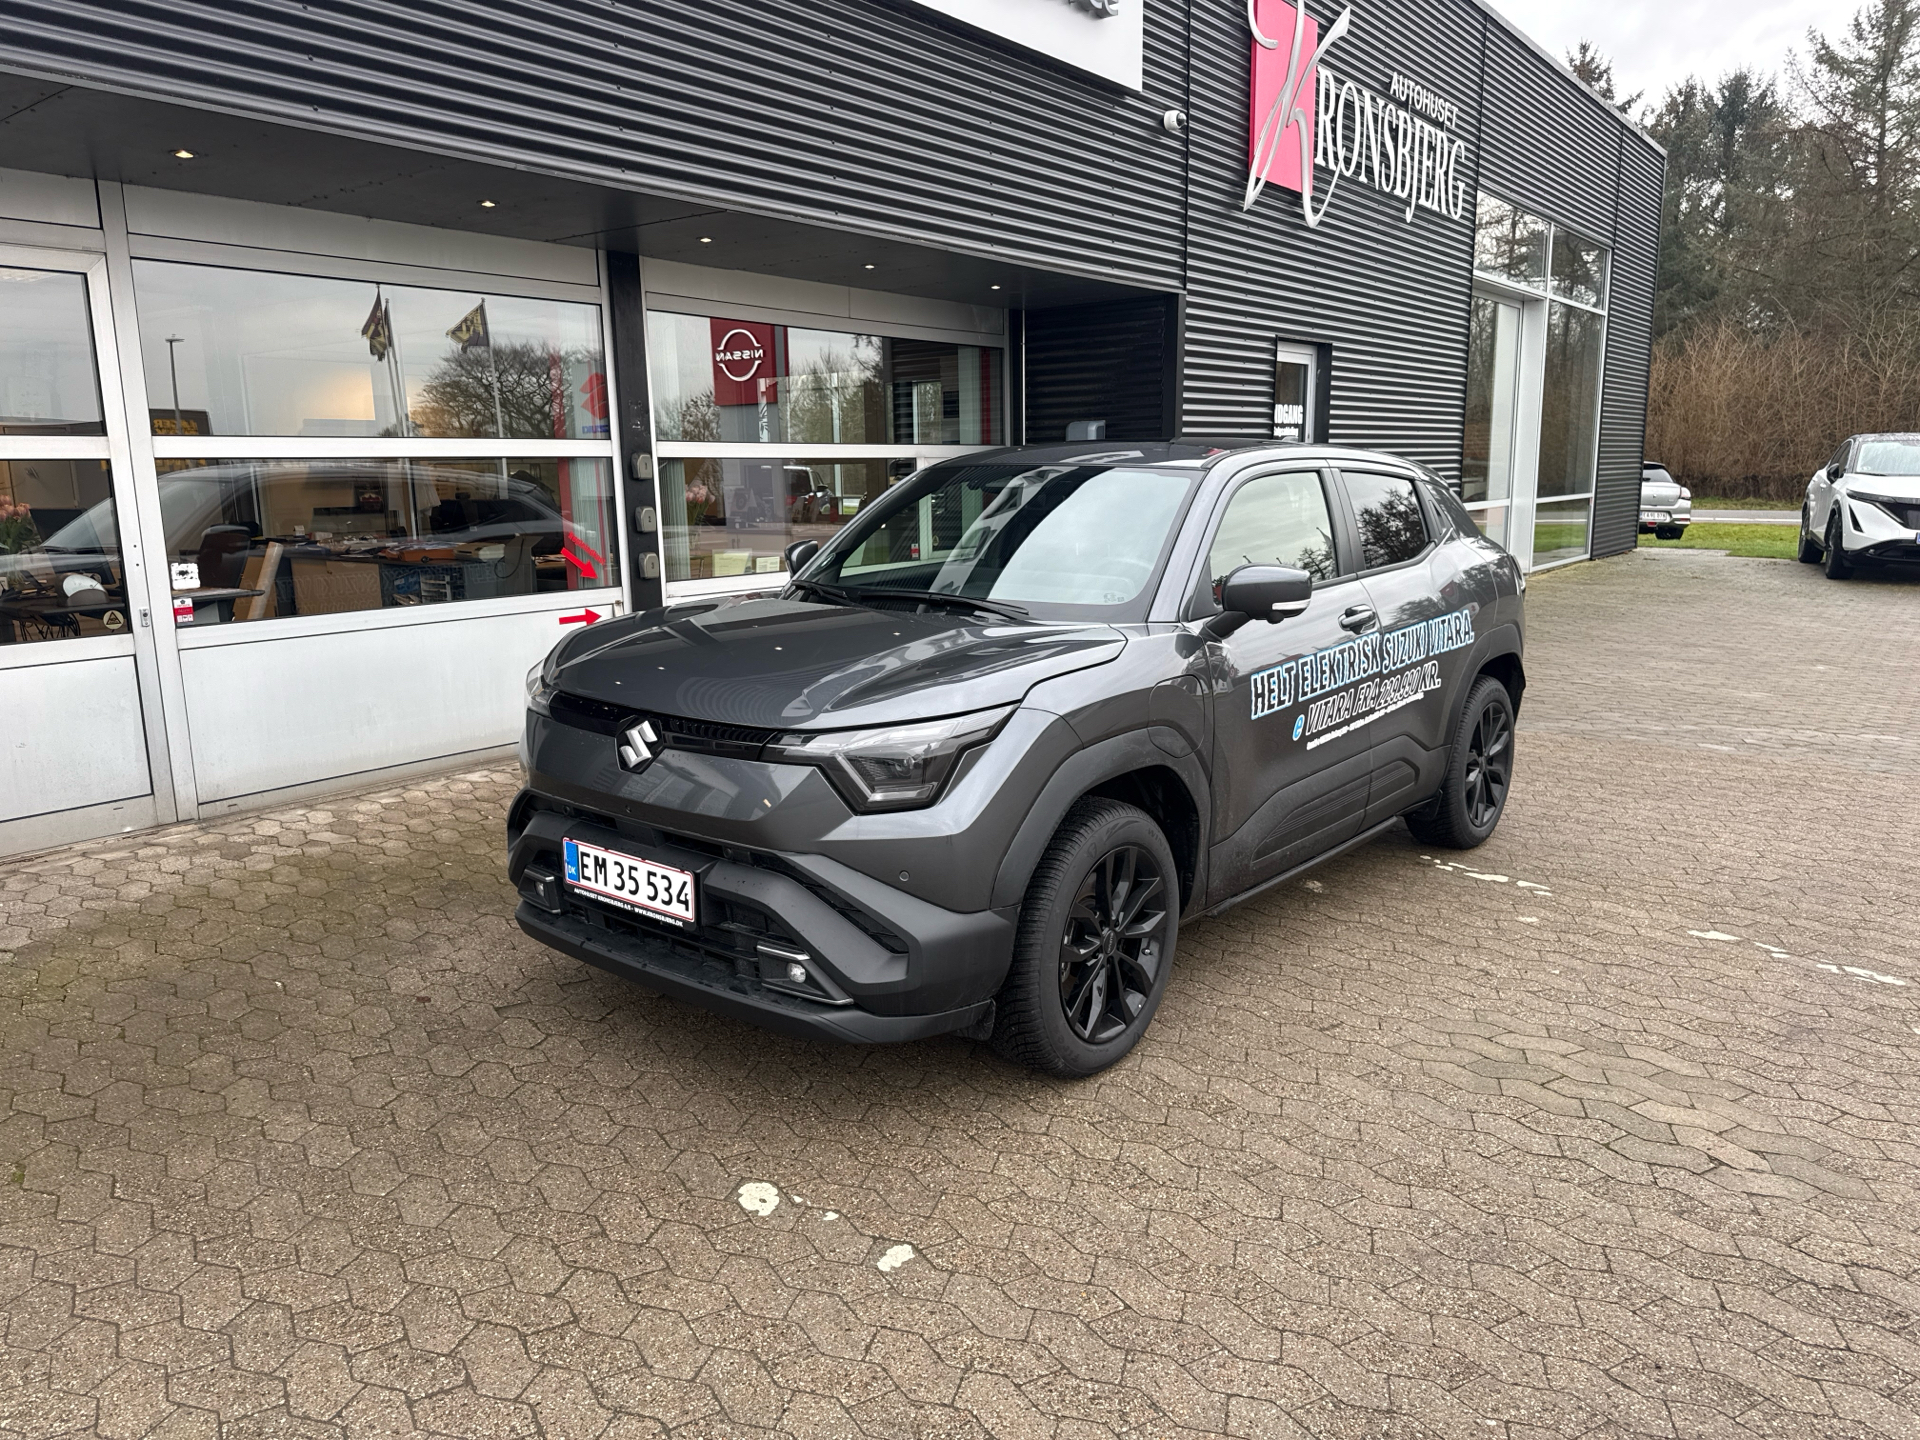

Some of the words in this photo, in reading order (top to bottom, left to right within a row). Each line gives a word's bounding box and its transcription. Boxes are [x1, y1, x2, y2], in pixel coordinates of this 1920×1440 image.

[1390, 72, 1459, 129] AUTOHUSET
[1250, 661, 1297, 720] HELT
[1298, 632, 1381, 702] ELEKTRISK
[1382, 620, 1429, 674] SUZUKI
[1428, 609, 1475, 656] VITARA.
[1292, 714, 1305, 741] e
[1305, 687, 1355, 736] VITARA
[1351, 677, 1380, 717] FRA
[1419, 660, 1442, 693] KR.
[567, 865, 577, 876] DK
[580, 851, 608, 887] EM
[614, 860, 640, 896] 35
[647, 870, 690, 912] 534
